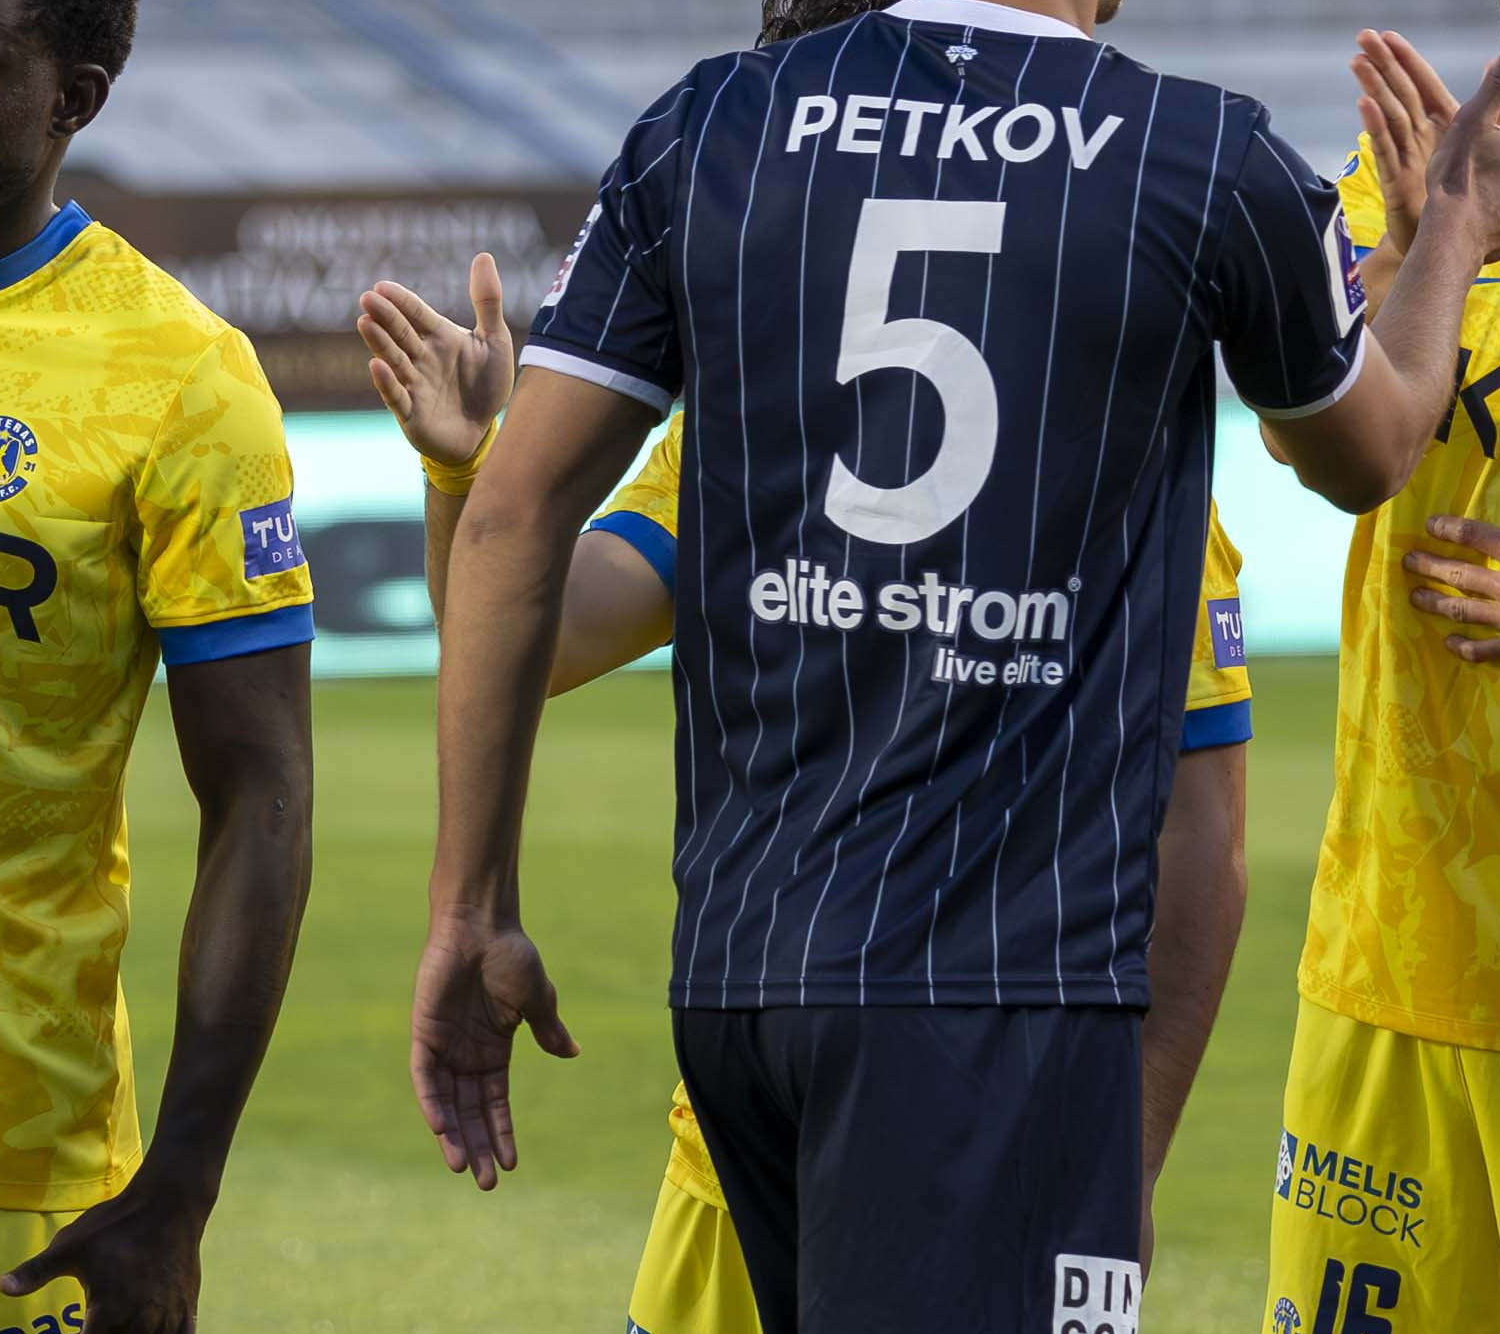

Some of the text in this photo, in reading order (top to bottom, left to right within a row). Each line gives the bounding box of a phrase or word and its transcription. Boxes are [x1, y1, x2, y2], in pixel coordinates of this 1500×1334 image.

[785, 95, 1124, 171] PETKOV
[824, 198, 1007, 546] 5
[252, 513, 295, 549] TU
[749, 558, 1069, 641] elite strom
[934, 647, 1064, 686] live elite
[1302, 1144, 1424, 1209] MELIS
[1296, 1179, 1425, 1249] BLOCK
